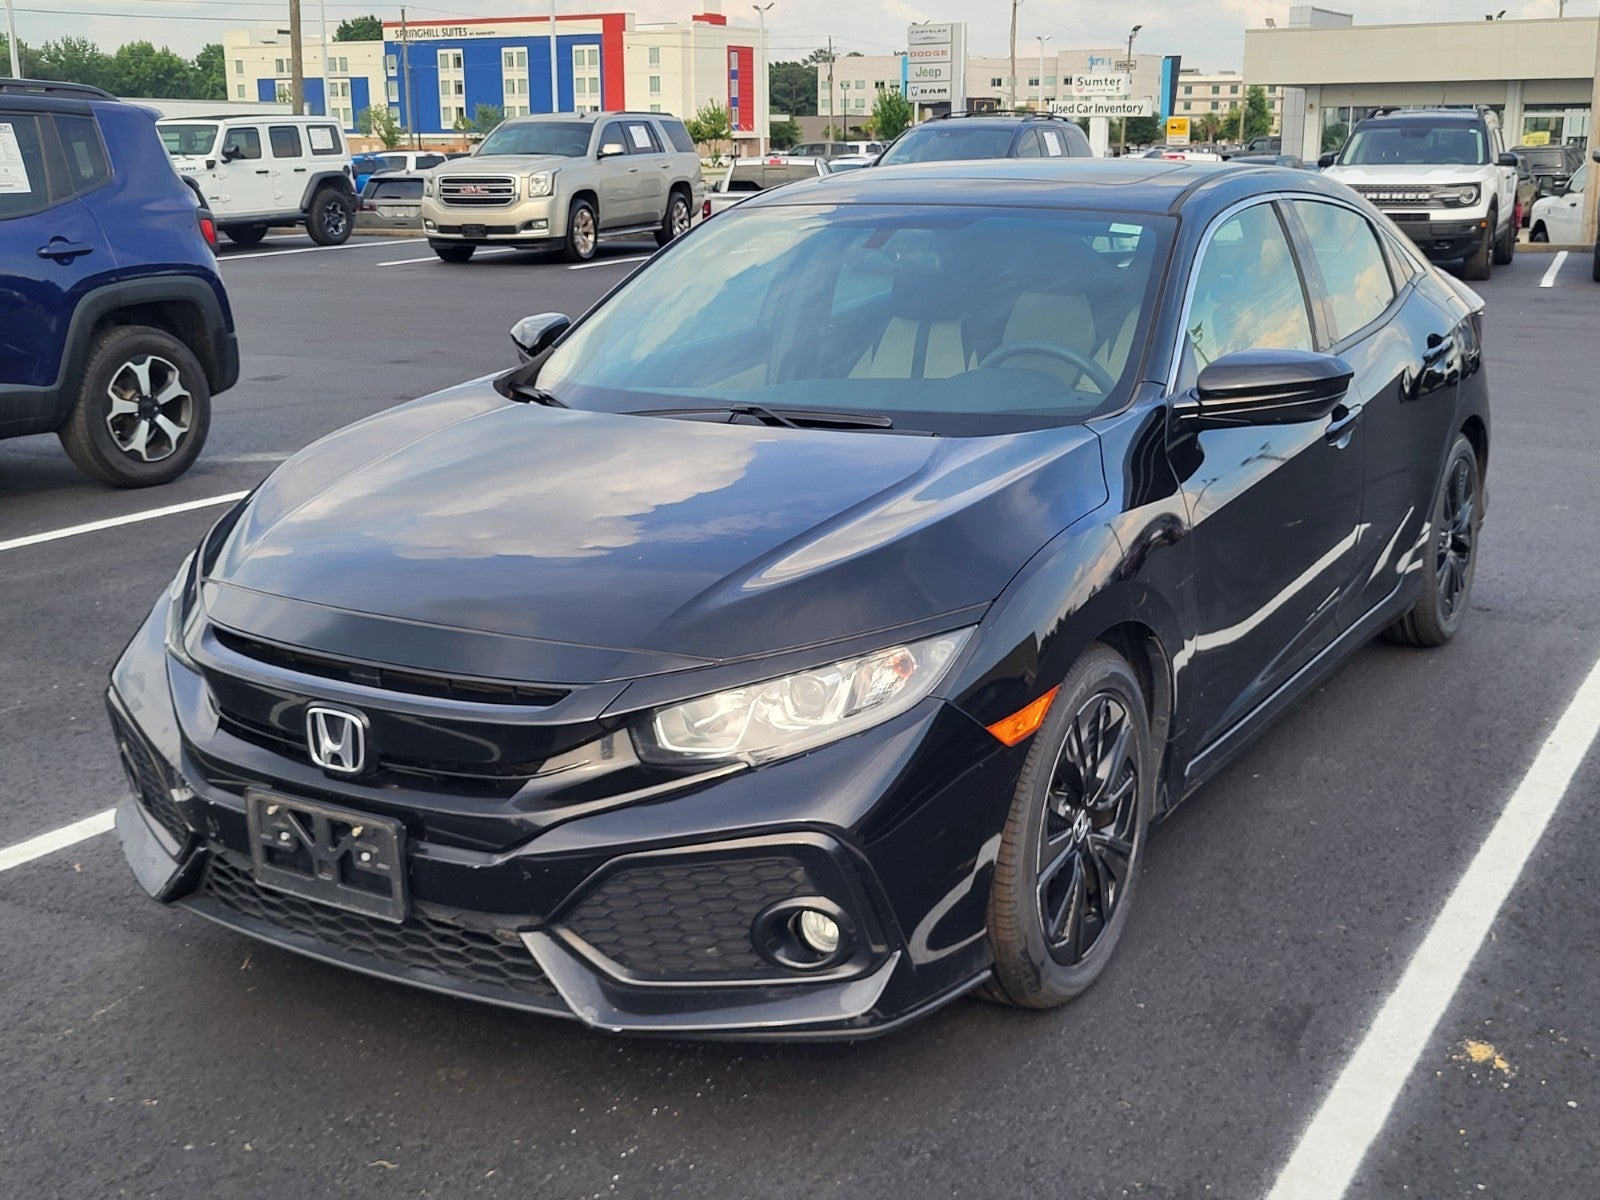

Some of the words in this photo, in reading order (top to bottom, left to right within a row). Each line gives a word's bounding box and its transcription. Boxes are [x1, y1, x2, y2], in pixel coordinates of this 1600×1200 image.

[395, 28, 440, 39] SPRINGHILL
[441, 27, 468, 37] SUITES
[915, 66, 942, 78] Jeep
[1077, 76, 1121, 86] Sumter
[1052, 103, 1074, 113] Used
[1076, 103, 1093, 113] Car
[1095, 103, 1143, 114] Inventory
[460, 186, 489, 195] GMC
